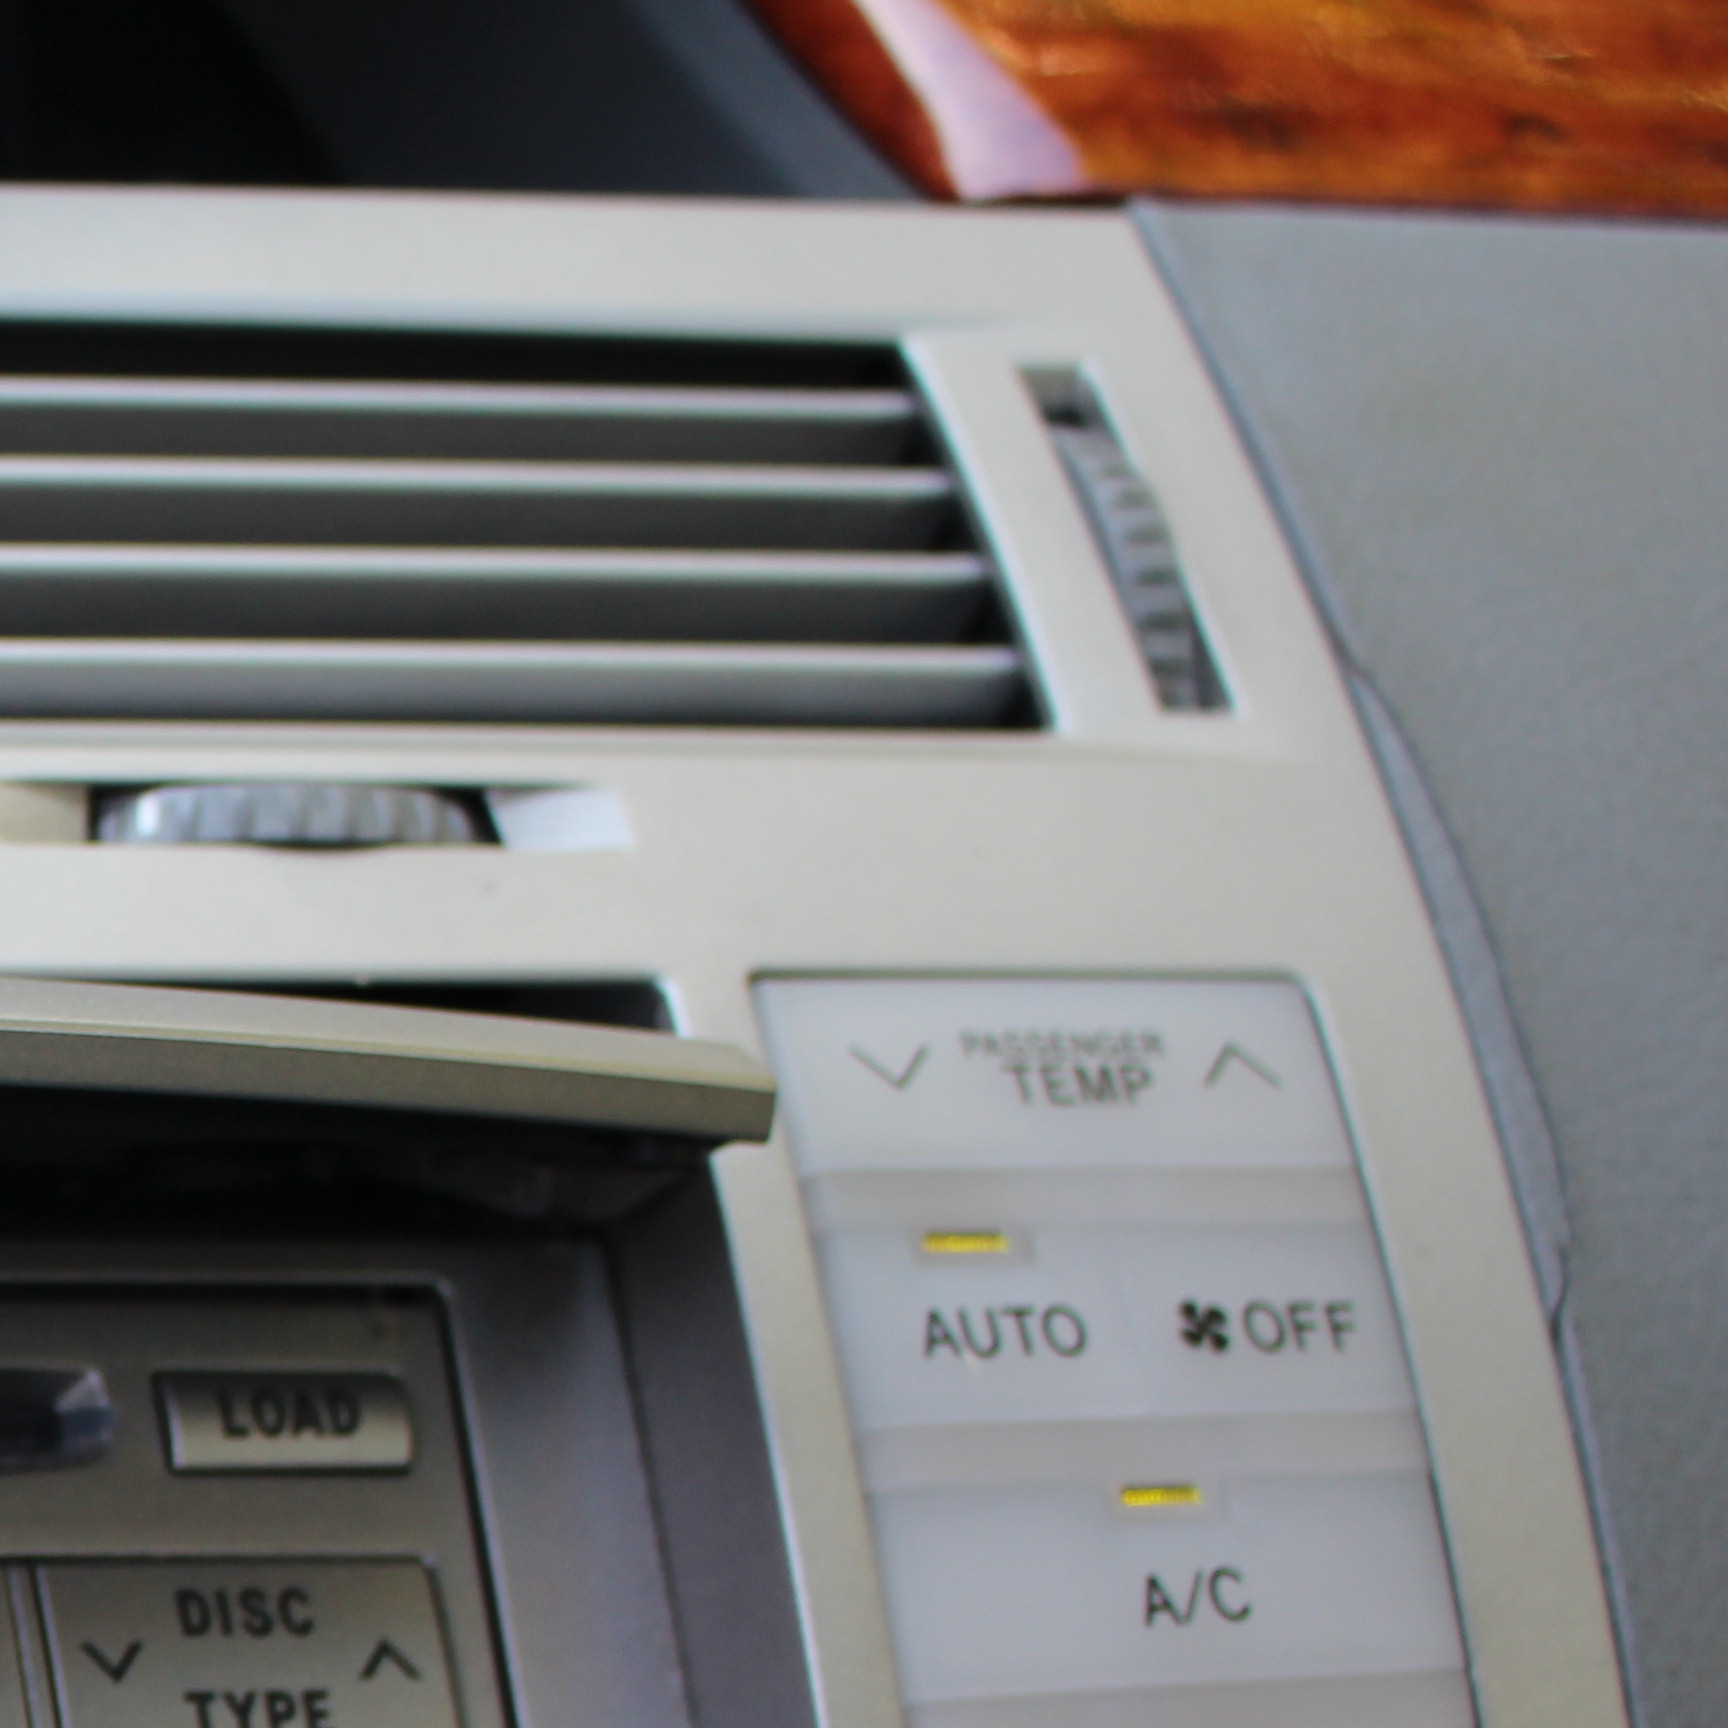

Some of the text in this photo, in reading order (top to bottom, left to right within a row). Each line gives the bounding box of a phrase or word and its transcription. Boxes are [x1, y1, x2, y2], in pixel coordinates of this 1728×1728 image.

[961, 1031, 1166, 1059] PASSENGER
[1001, 1060, 1152, 1104] TEMP
[923, 1303, 1088, 1358] AUTO
[1241, 1300, 1357, 1354] OFF
[218, 1385, 364, 1438] LOAD
[174, 1586, 315, 1638] DISC
[1144, 1567, 1251, 1626] A/C
